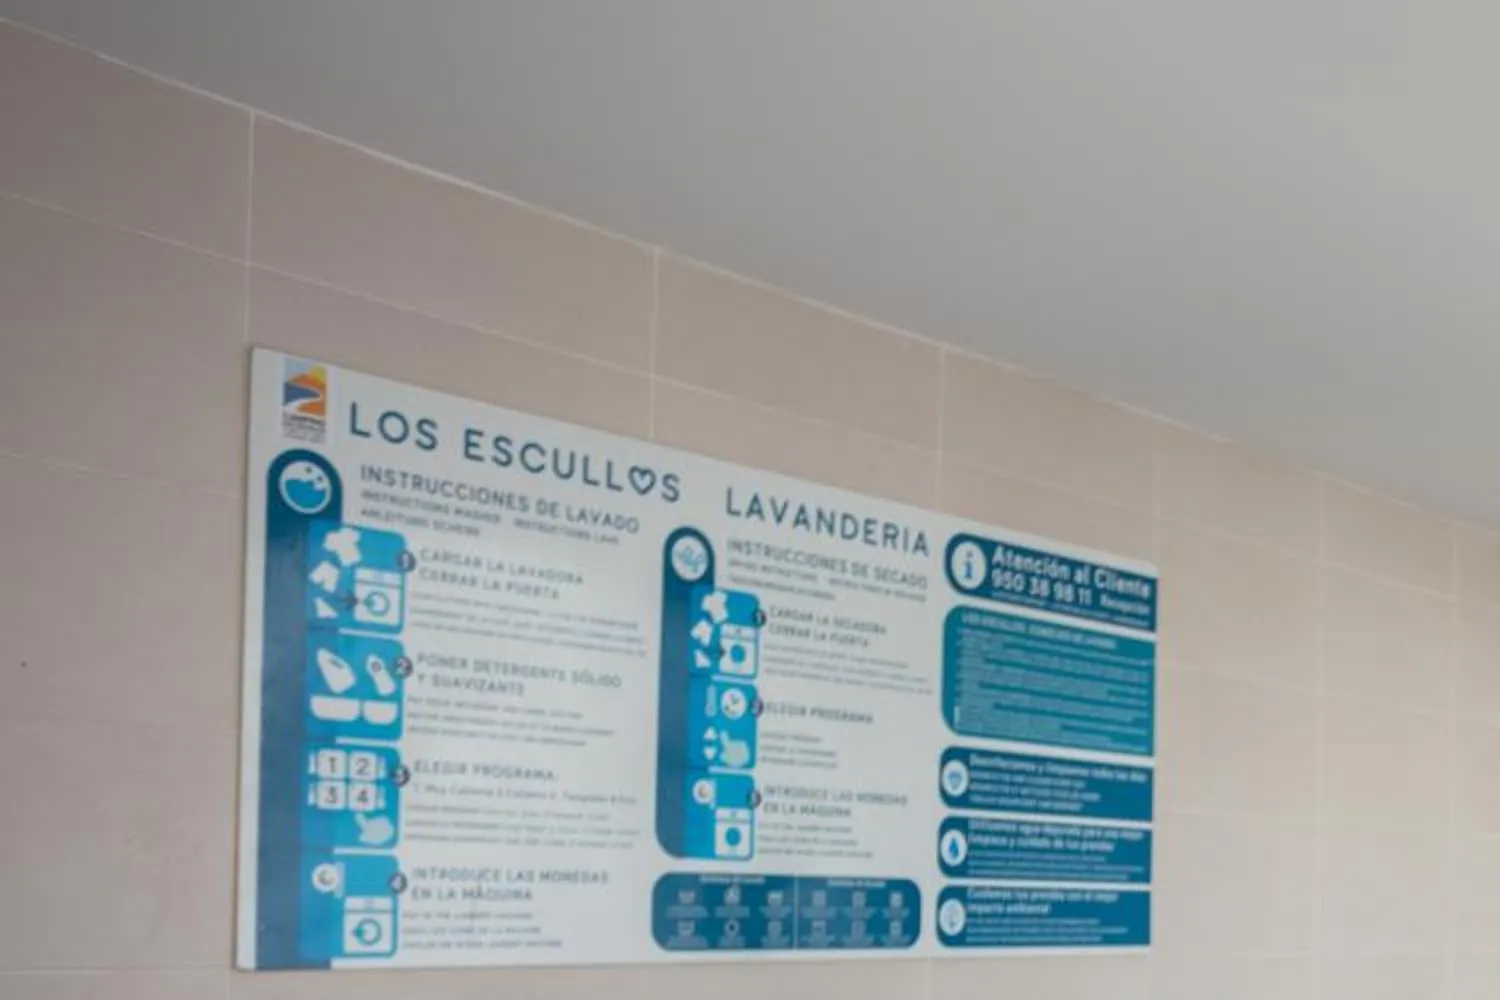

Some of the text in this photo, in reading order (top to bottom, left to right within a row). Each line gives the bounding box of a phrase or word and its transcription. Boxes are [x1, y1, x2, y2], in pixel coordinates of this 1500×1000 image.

[350, 400, 439, 452] LOS
[360, 463, 641, 535] INSTRUCCIONES DE LAVADO
[725, 486, 931, 558] LAVANDERIA
[727, 537, 848, 575] INSTRUCCIONES
[874, 565, 929, 591] SECADO
[991, 545, 1071, 580] Atención
